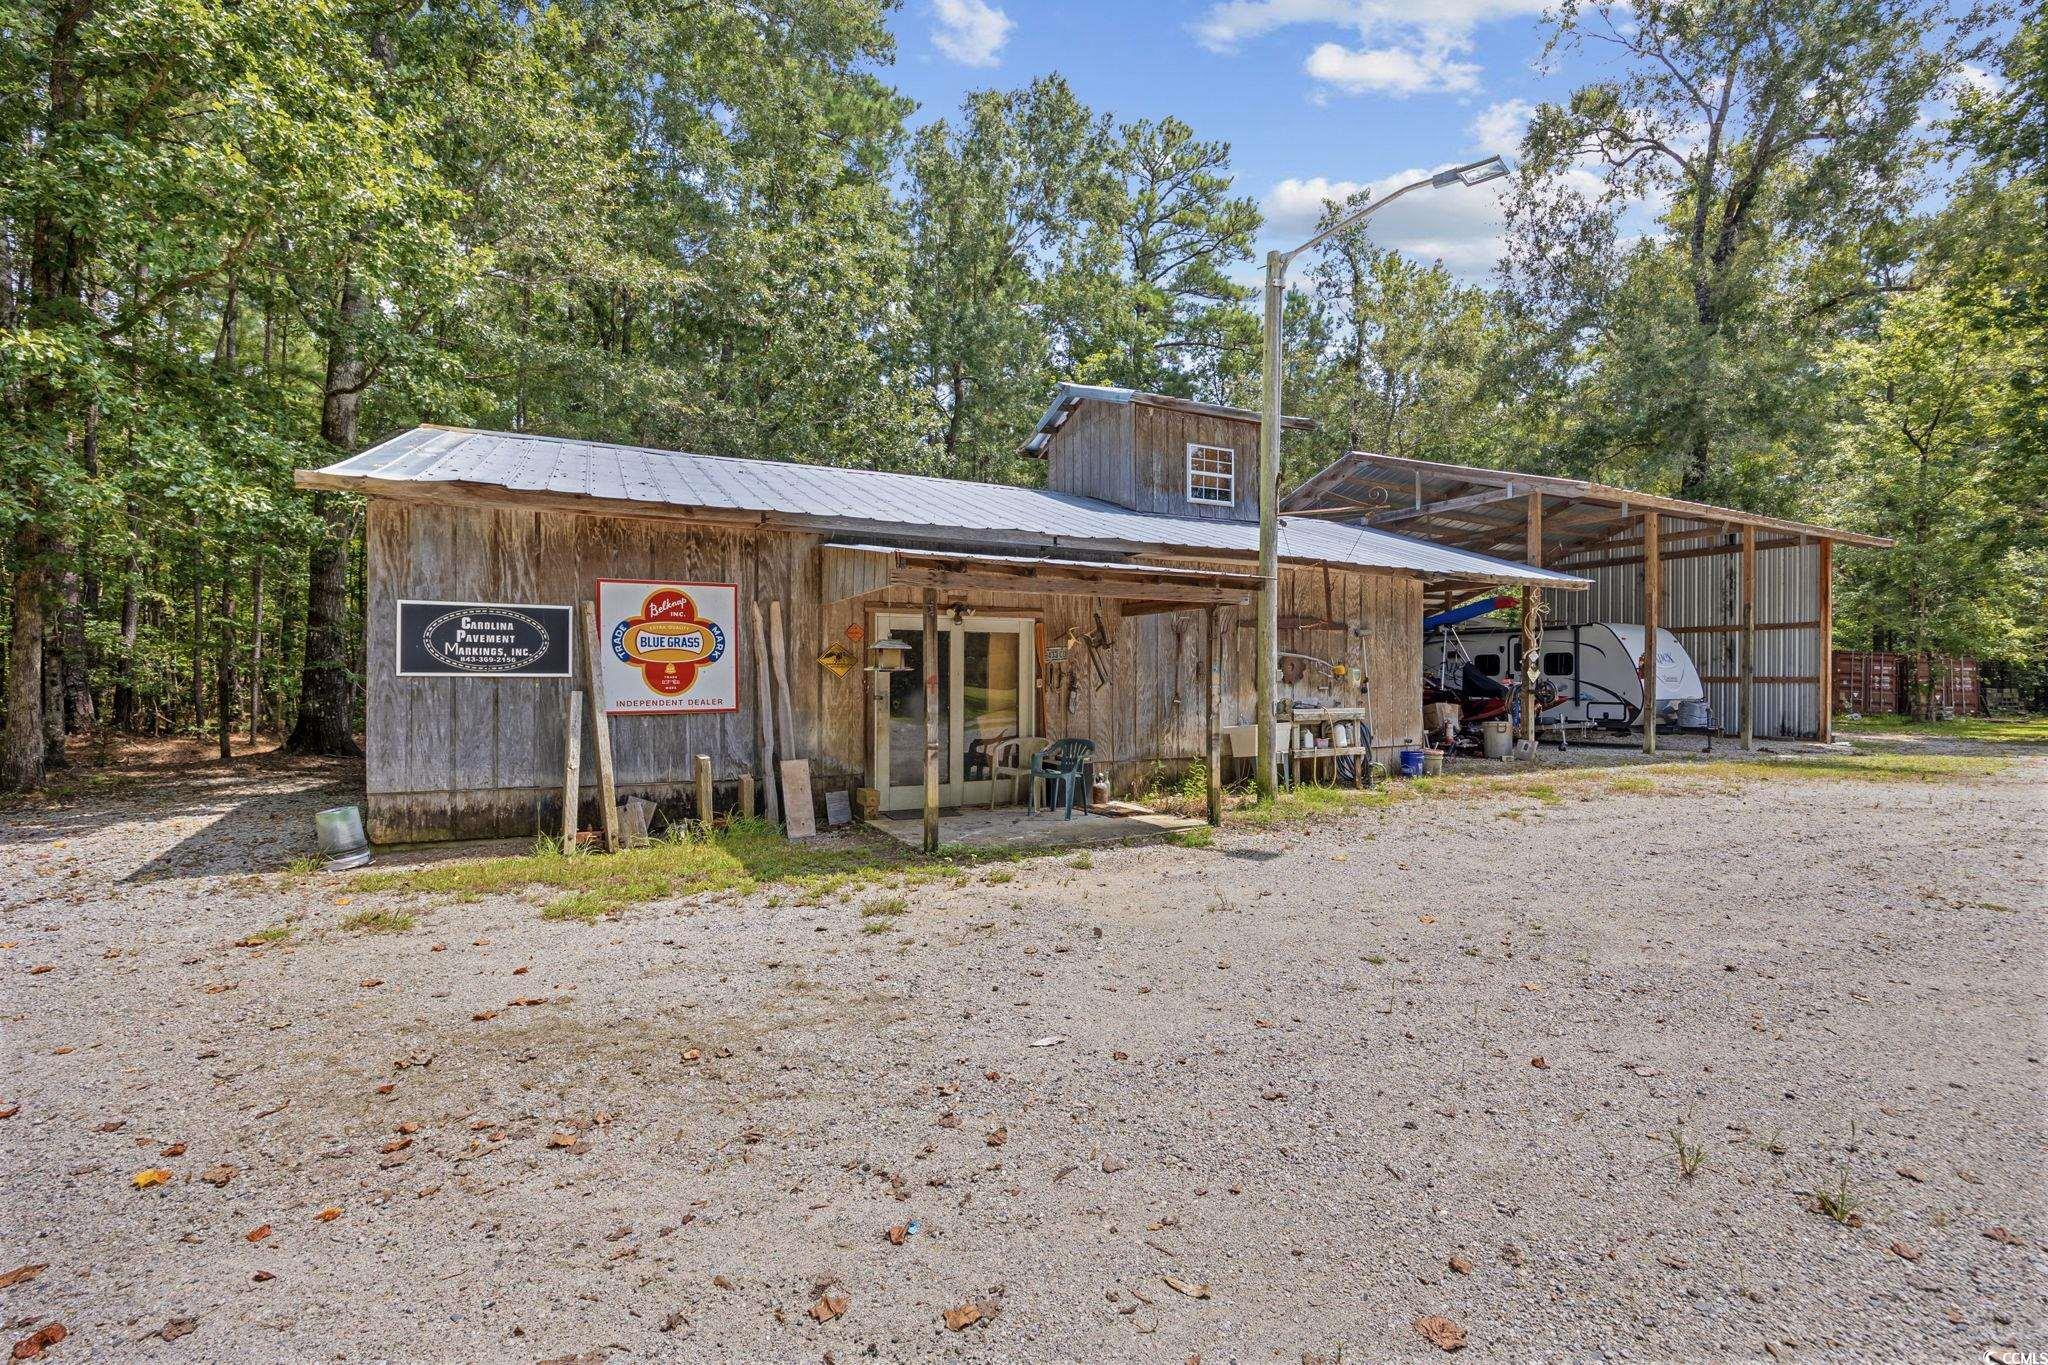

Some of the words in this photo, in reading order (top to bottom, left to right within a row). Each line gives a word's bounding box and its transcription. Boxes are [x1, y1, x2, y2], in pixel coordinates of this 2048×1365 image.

[649, 597, 687, 618] Belknap
[461, 616, 514, 631] CAROLINA
[456, 630, 516, 644] PAVEMENT
[615, 624, 627, 659] TRADE
[640, 636, 666, 648] BLUE
[667, 636, 700, 648] GRASS
[711, 626, 723, 659] MARK
[445, 642, 508, 657] MARKINGS,
[511, 648, 533, 657] INC.
[616, 699, 683, 708] INDEPENDENT
[688, 698, 724, 707] DEALER
